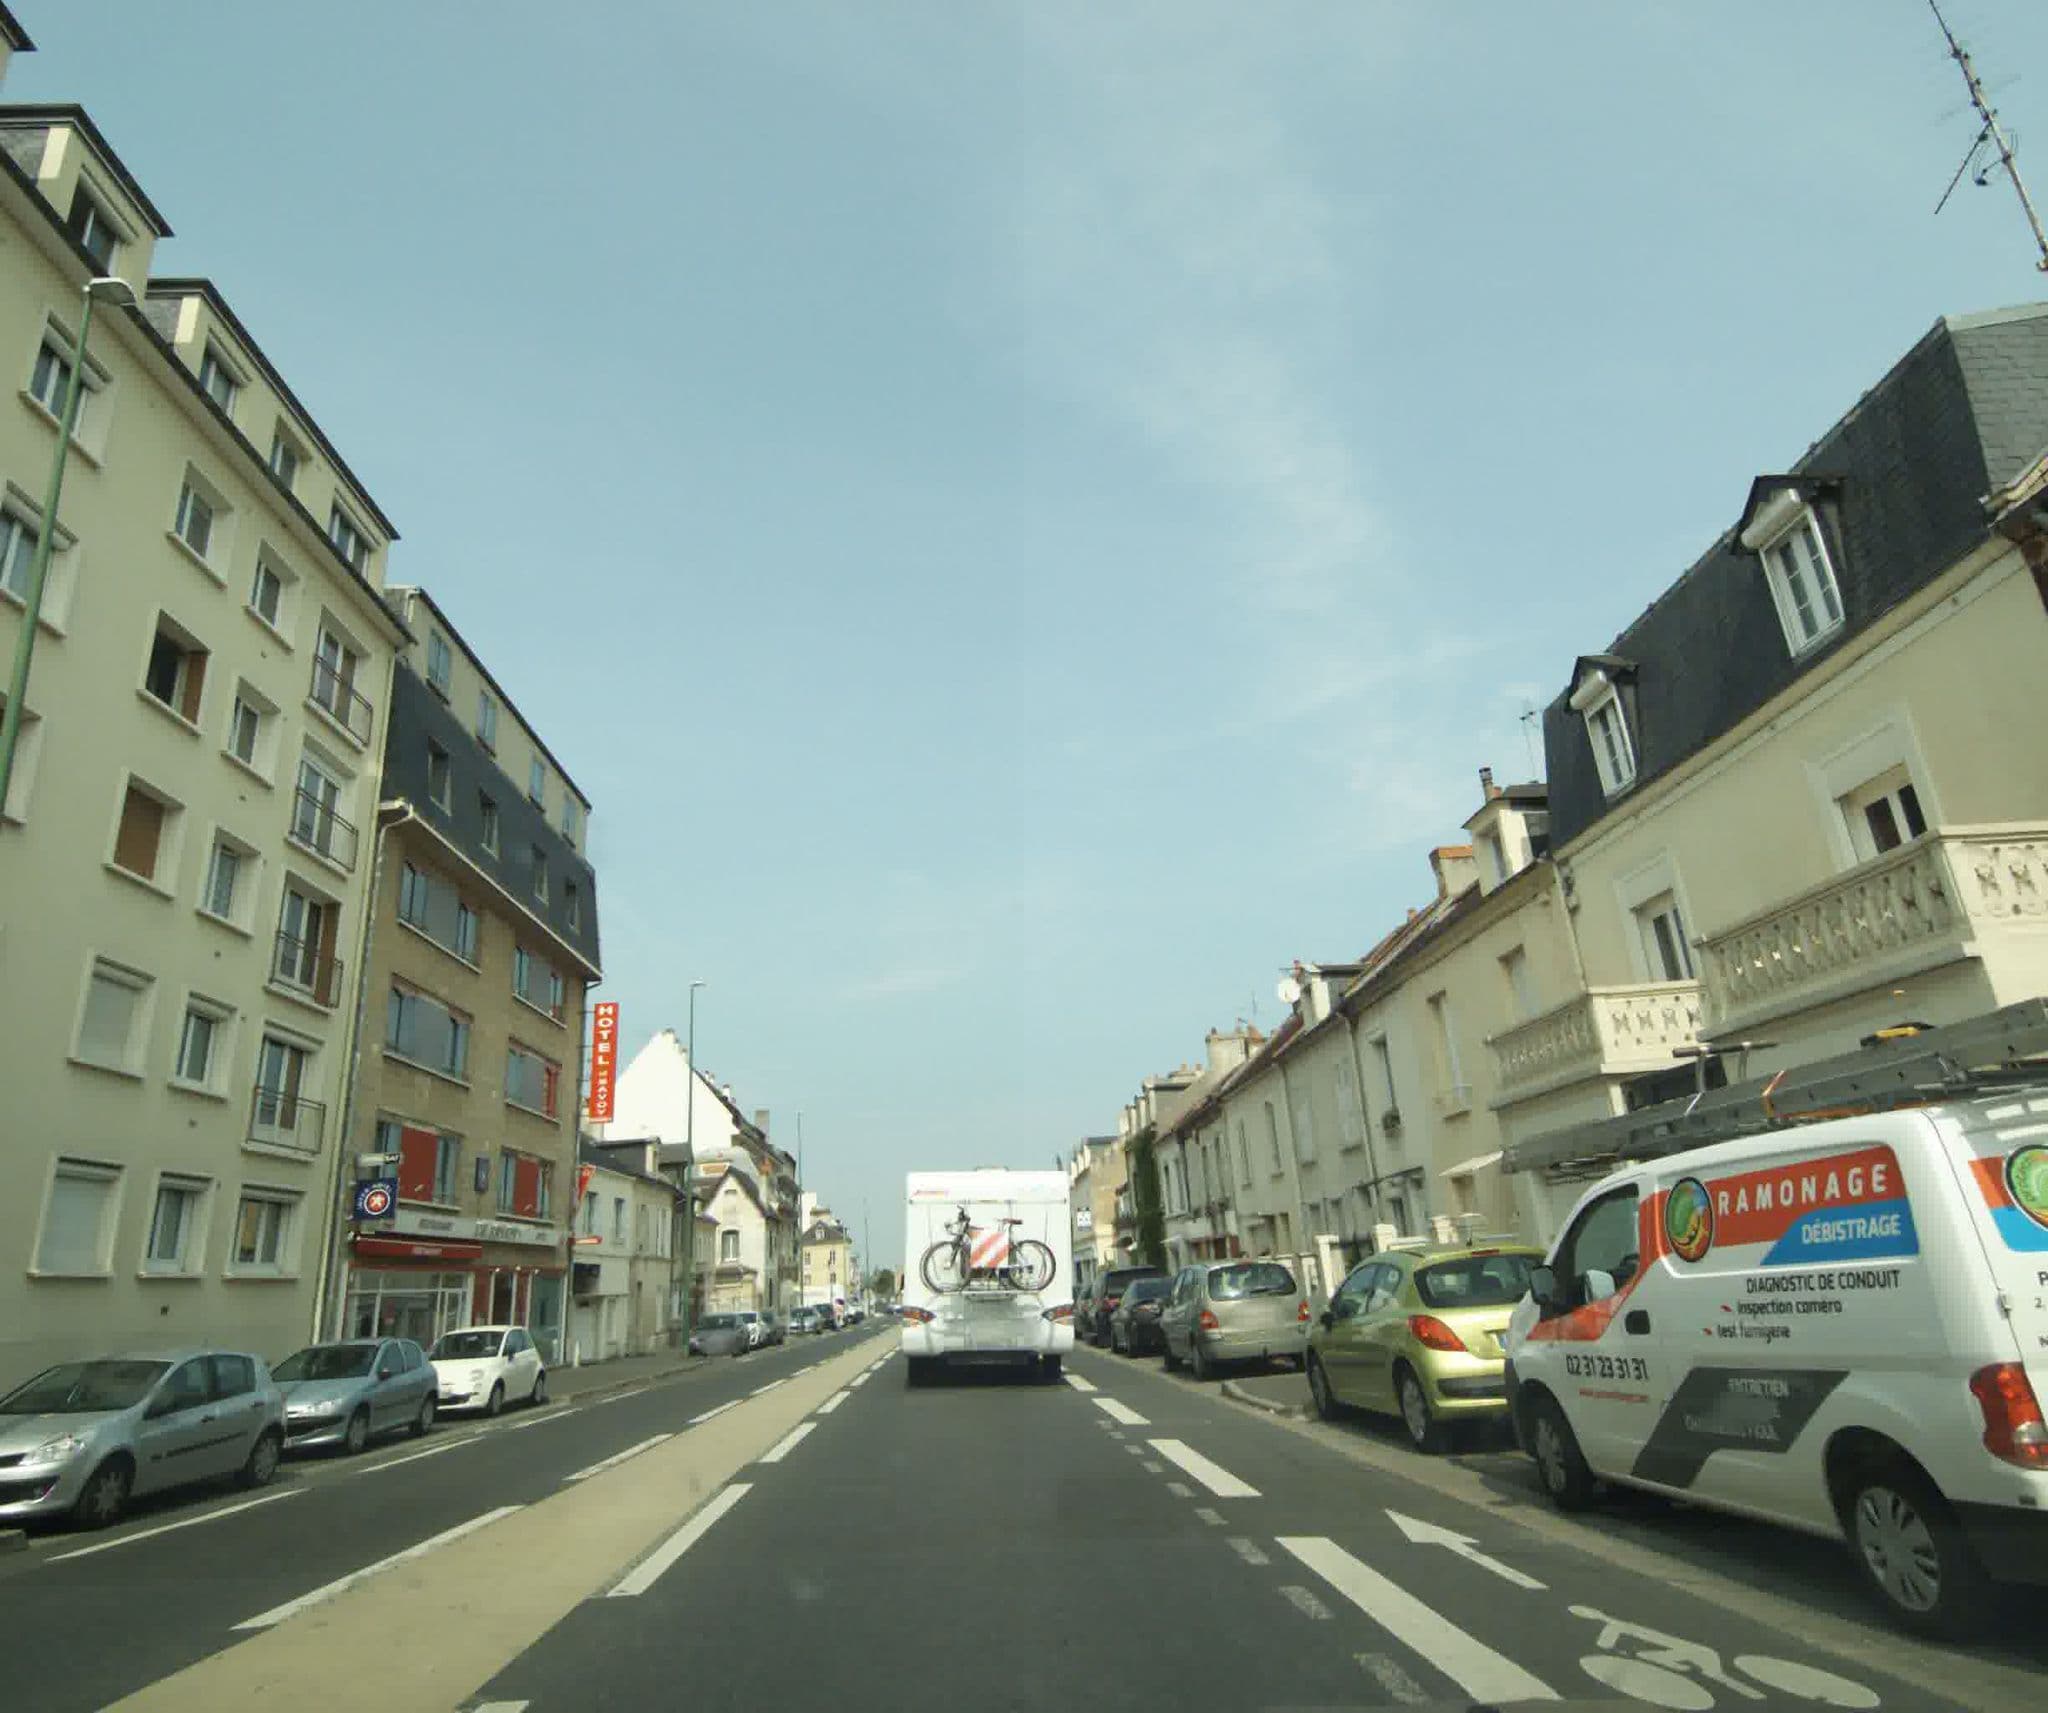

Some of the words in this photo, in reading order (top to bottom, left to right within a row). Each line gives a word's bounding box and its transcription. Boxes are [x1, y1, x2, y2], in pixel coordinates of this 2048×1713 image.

[597, 1005, 614, 1065] HOTEL
[1718, 1163, 1889, 1217] RAMONAGE
[1802, 1213, 1901, 1245] DÉBISTRAGE
[1746, 1275, 1814, 1293] DIAGNOSTIC
[1818, 1273, 1834, 1290] DE
[1838, 1269, 1900, 1289] CONDUIT
[1566, 1354, 1581, 1376] 02
[1582, 1355, 1596, 1377] 31
[1597, 1356, 1614, 1378] 23
[1615, 1357, 1631, 1379] 31
[1631, 1357, 1648, 1380] 31
